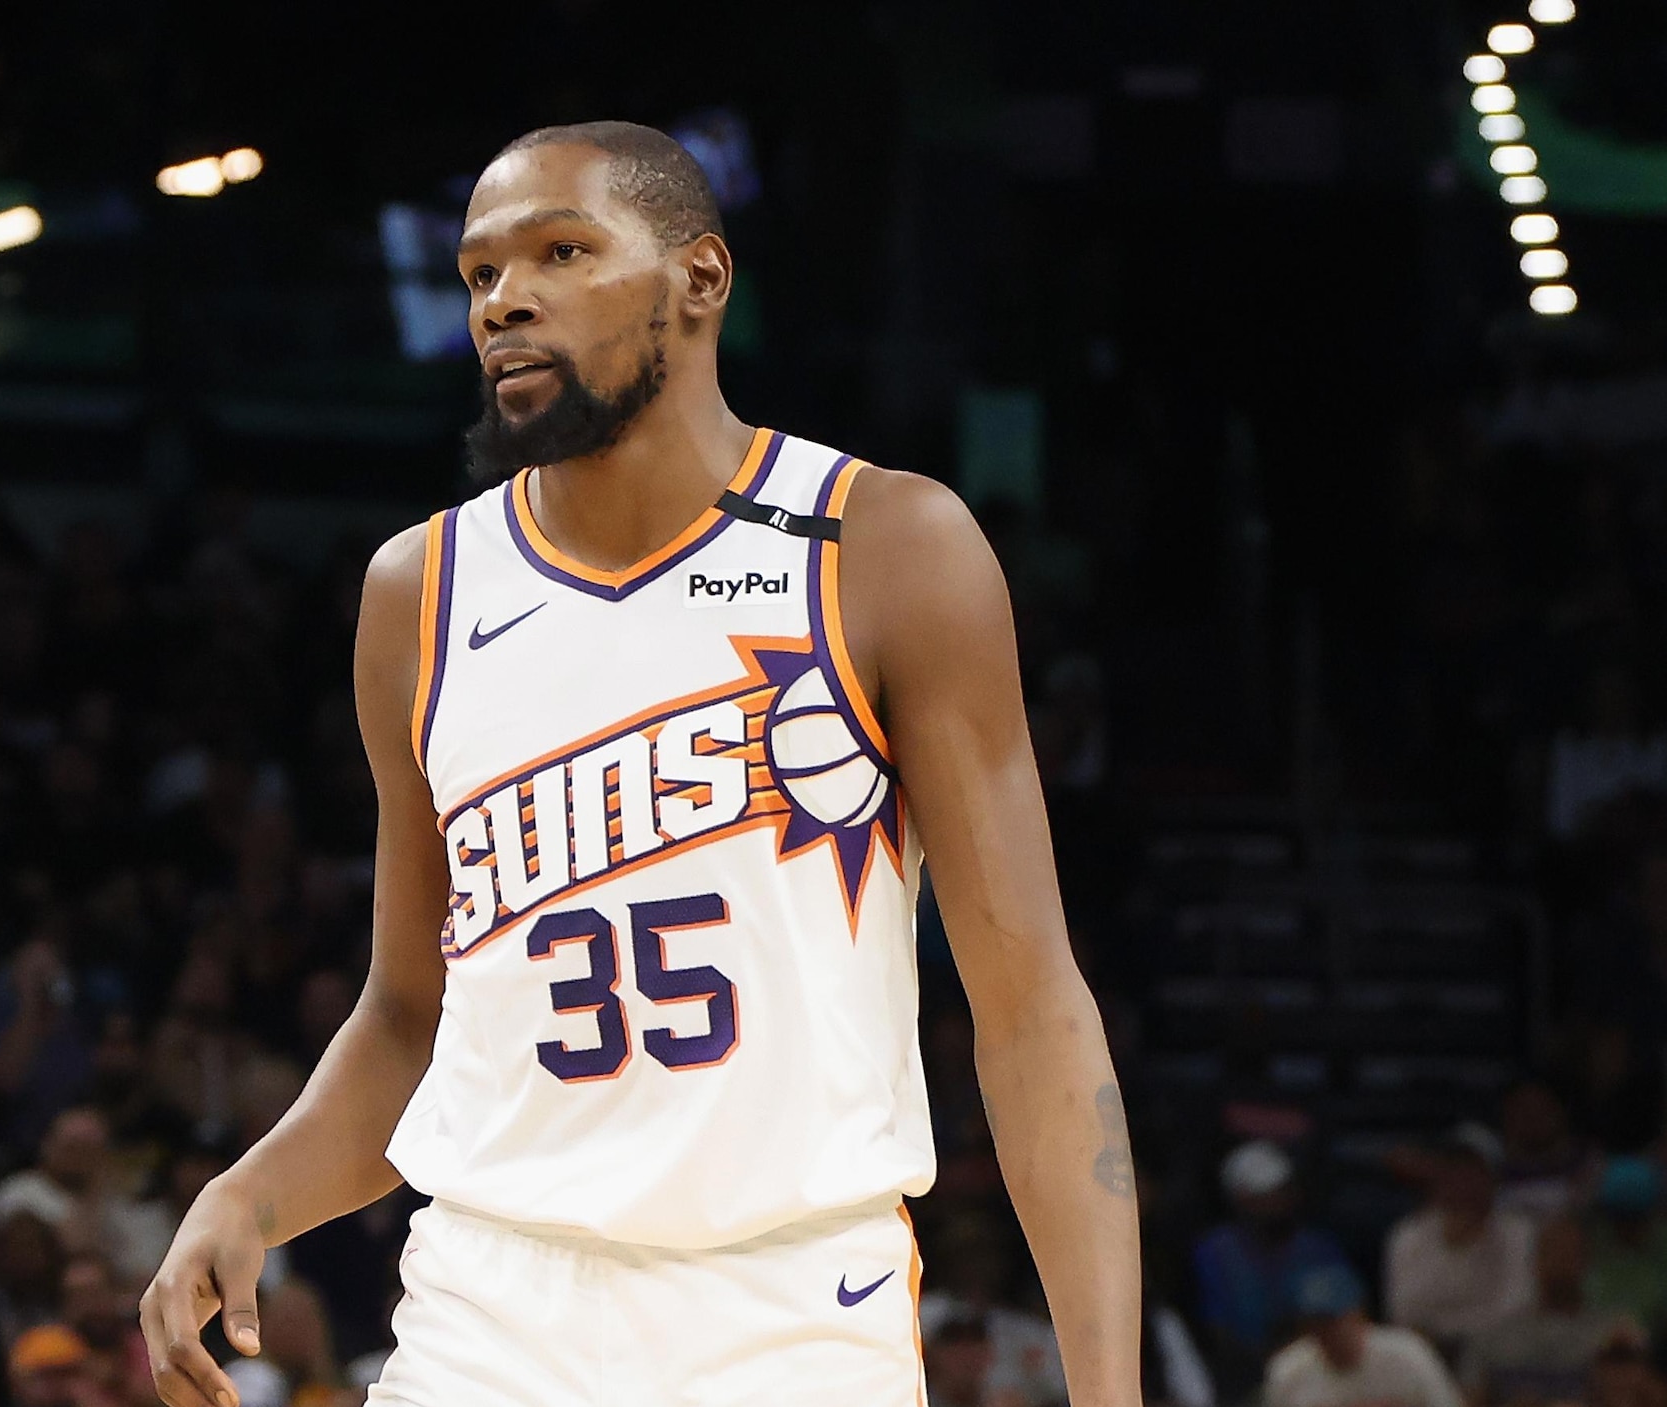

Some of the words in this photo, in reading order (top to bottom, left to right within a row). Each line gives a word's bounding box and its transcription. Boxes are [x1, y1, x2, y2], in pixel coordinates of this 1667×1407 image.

[768, 509, 789, 530] AL
[689, 572, 788, 602] PayPal
[527, 893, 740, 1084] 35
